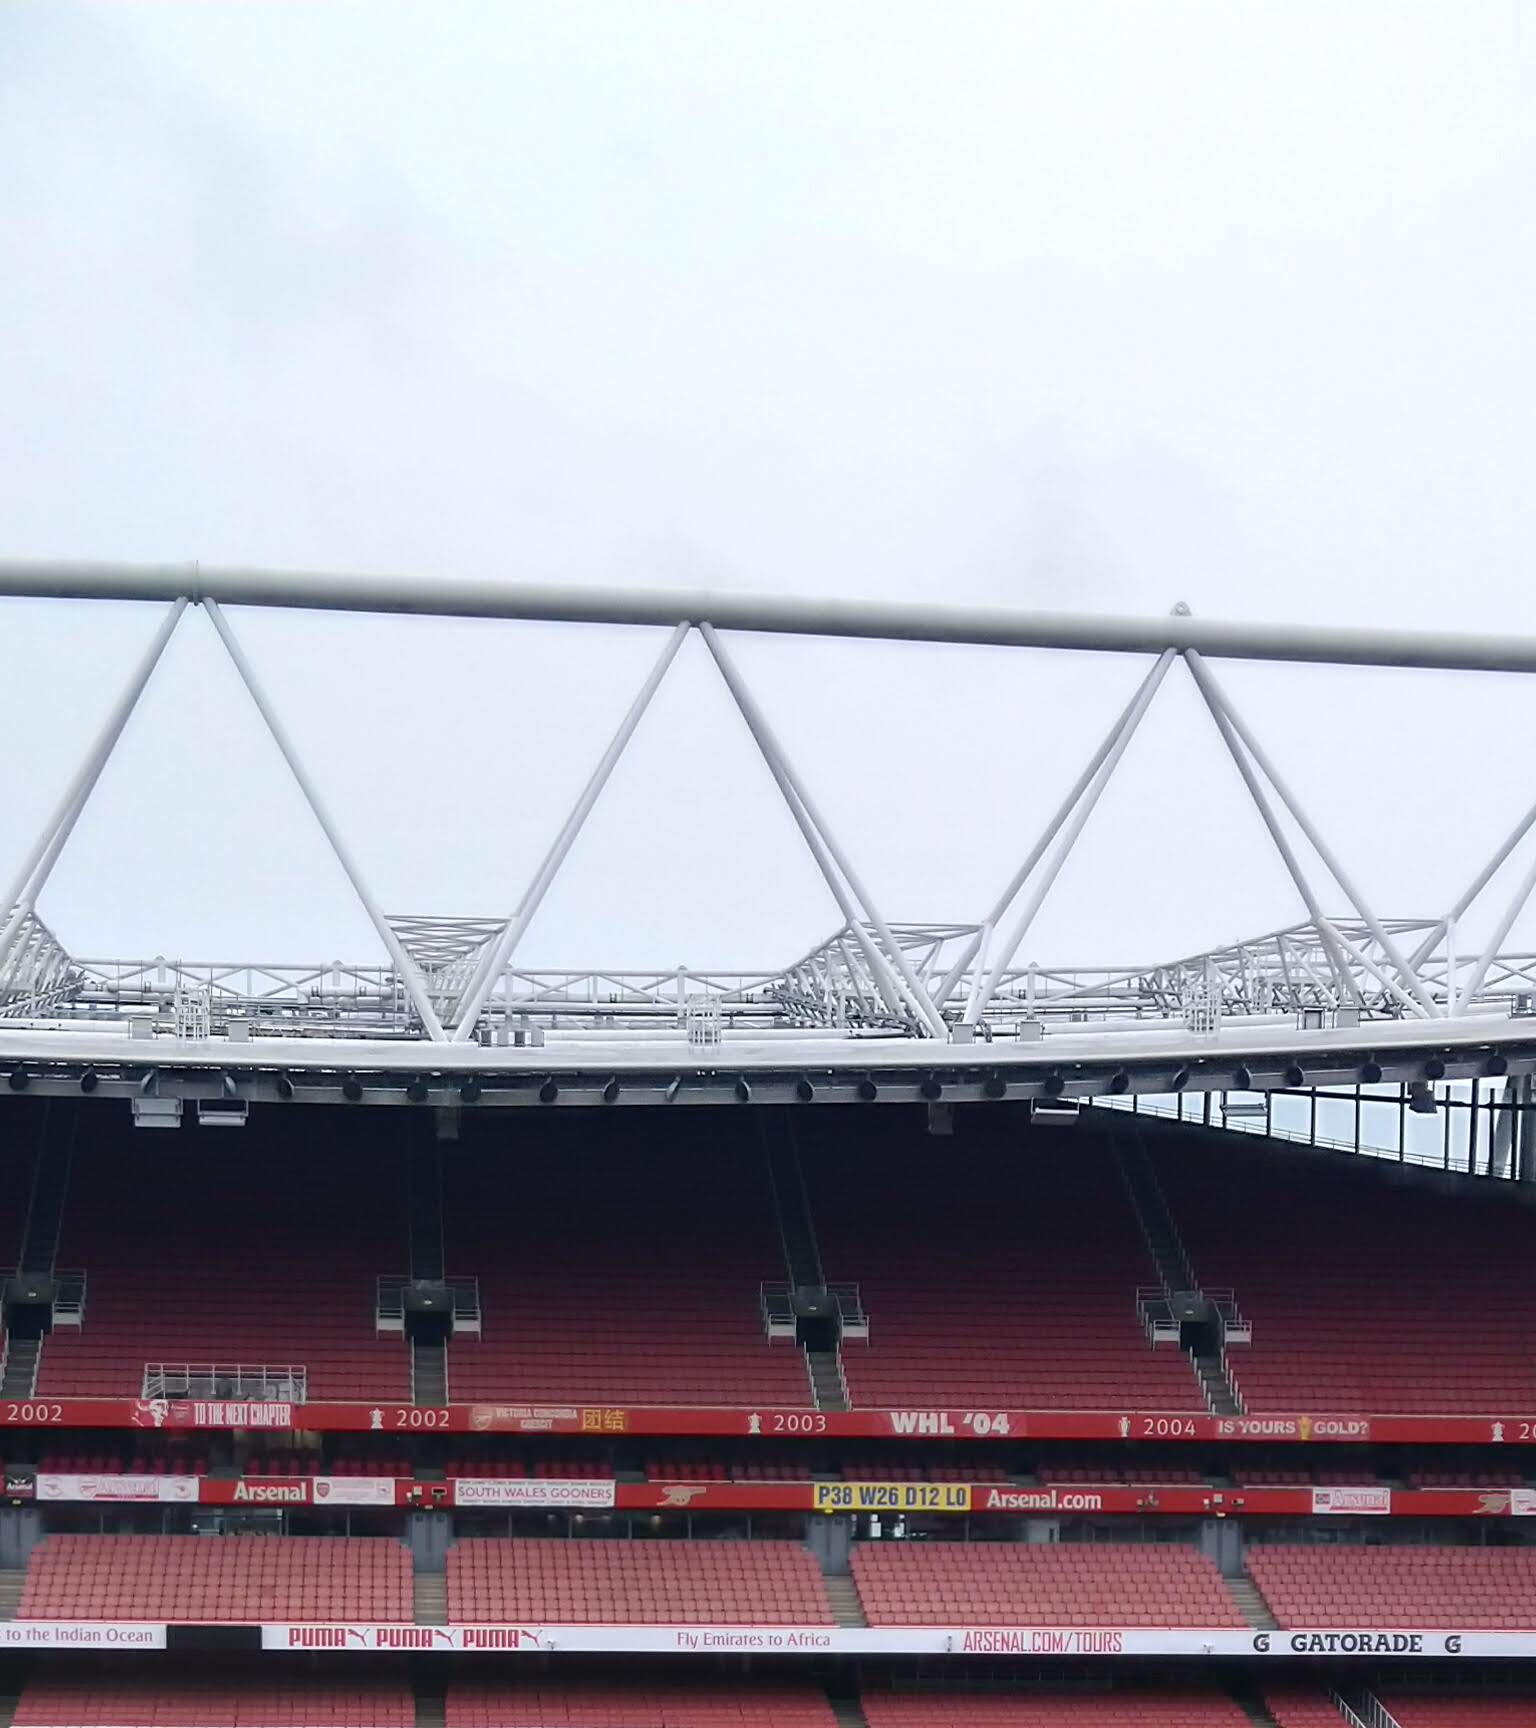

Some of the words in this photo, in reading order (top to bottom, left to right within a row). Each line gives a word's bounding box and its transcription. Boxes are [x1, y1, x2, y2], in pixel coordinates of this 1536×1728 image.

[7, 1404, 63, 1422] 2002
[194, 1402, 206, 1425] TO
[208, 1403, 224, 1425] THE
[226, 1403, 248, 1426] NEXT
[250, 1404, 291, 1426] CHAPTER
[396, 1410, 449, 1428] 2002
[582, 1409, 625, 1430] 团结
[774, 1414, 826, 1431] 2003
[890, 1412, 954, 1433] WHL
[1143, 1418, 1196, 1435] 2004
[1219, 1421, 1234, 1434] IS
[1239, 1421, 1296, 1434] YOURS
[1314, 1421, 1368, 1435] GOLD?
[233, 1482, 306, 1501] Arsenal
[458, 1487, 501, 1499] SOUTH
[504, 1487, 547, 1499] WALES
[550, 1488, 612, 1500] GOONERS
[819, 1486, 852, 1505] P38
[859, 1486, 898, 1505] W26
[906, 1487, 938, 1506] D12
[986, 1489, 1102, 1509] Arsenal.com
[6, 1628, 22, 1641] to
[27, 1627, 49, 1642] the
[55, 1627, 101, 1642] Indian
[106, 1628, 153, 1643] Ocean
[289, 1628, 345, 1647] PUMA
[376, 1628, 432, 1648] PUMA
[463, 1629, 519, 1648] PUMA
[677, 1631, 698, 1649] Fly
[704, 1631, 763, 1646] Emirates
[768, 1633, 783, 1646] to
[787, 1631, 830, 1647] Africa
[963, 1631, 1123, 1654] ARSENAL.COM/TOURS
[1253, 1633, 1270, 1654] G
[1291, 1633, 1423, 1653] GATORADE
[1444, 1634, 1462, 1654] G
